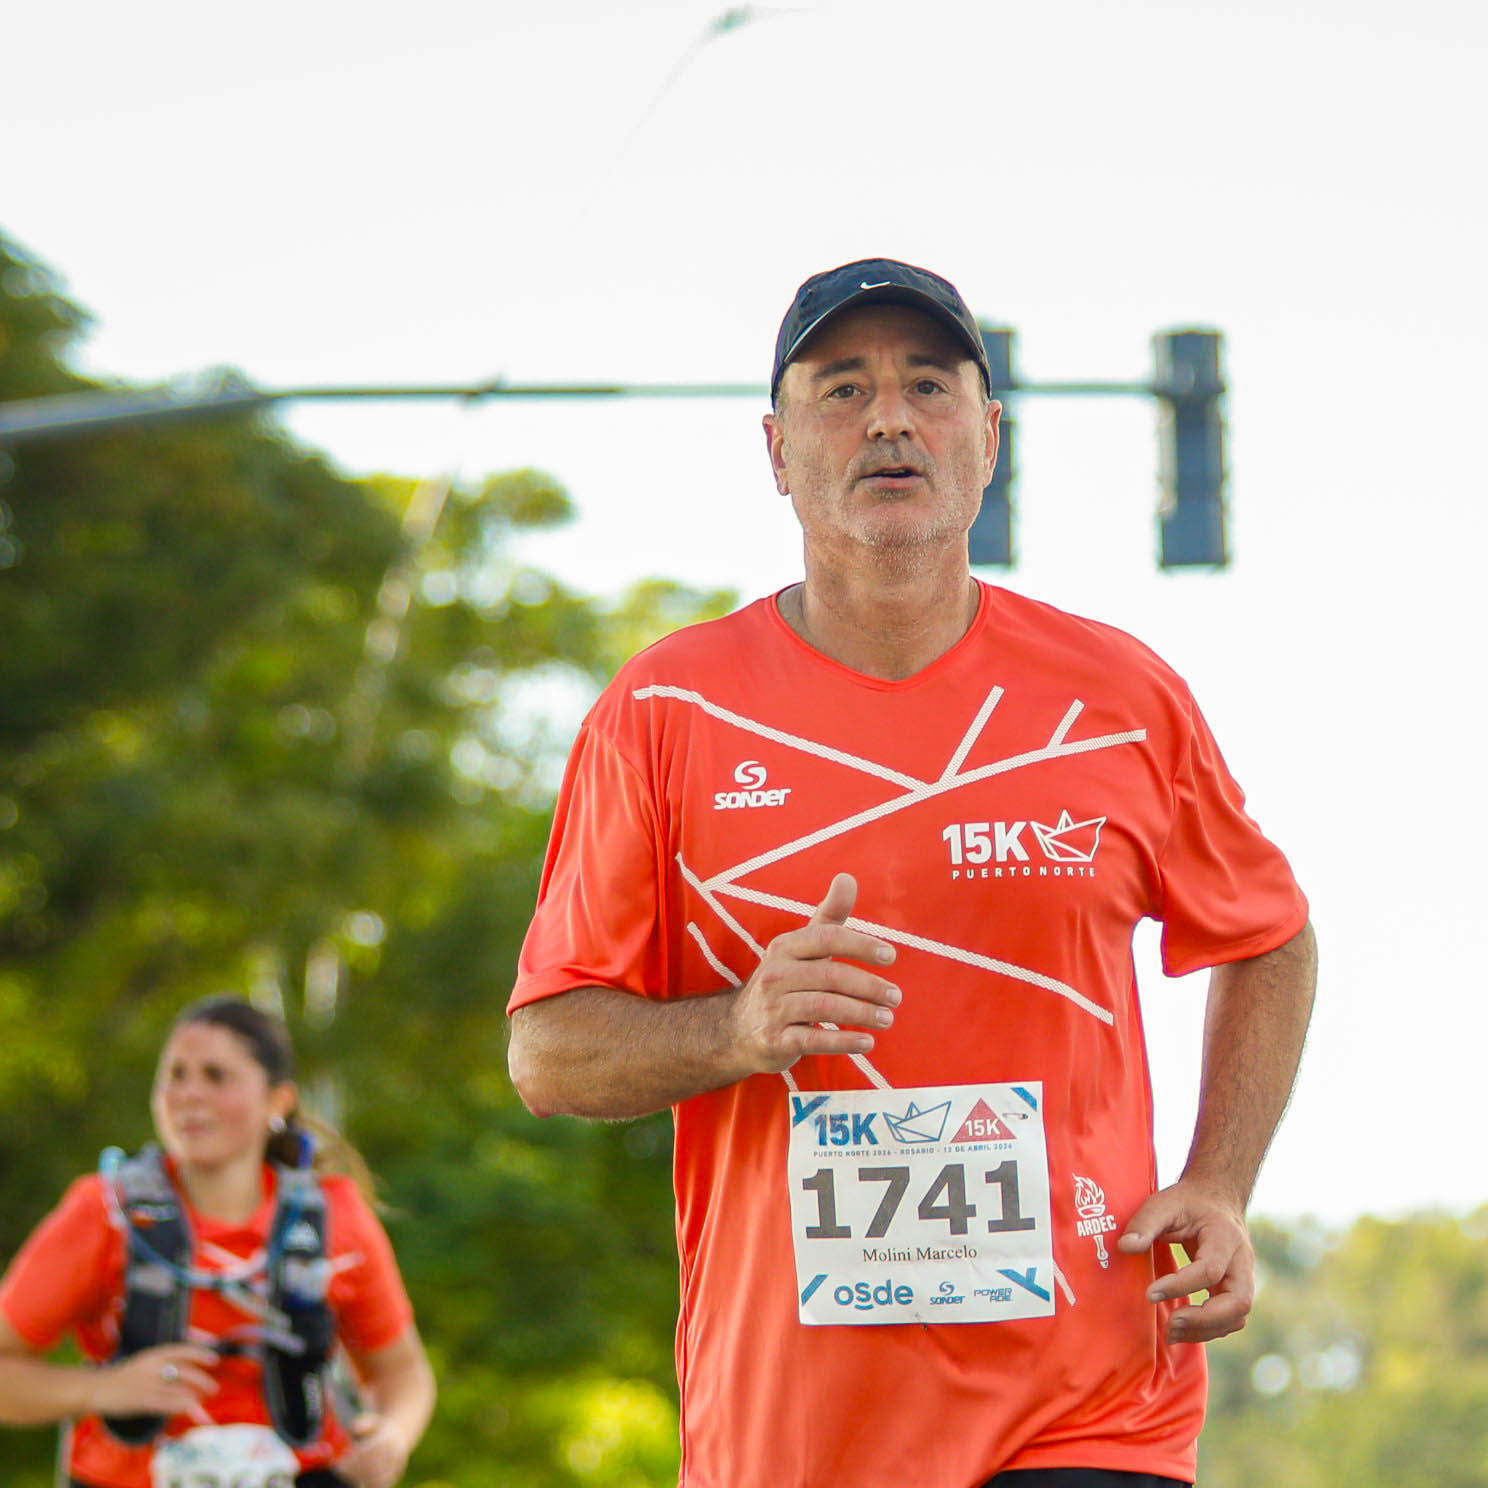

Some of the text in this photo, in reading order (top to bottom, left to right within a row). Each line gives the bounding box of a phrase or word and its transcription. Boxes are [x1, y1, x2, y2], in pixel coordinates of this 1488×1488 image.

[943, 821, 1030, 865] 15K
[952, 866, 1096, 880] PUERTO NORTE
[815, 1112, 879, 1146] 15K
[965, 1118, 1001, 1137] 15K
[813, 1150, 843, 1158] PUERTO
[845, 1149, 870, 1157] NORTE
[900, 1146, 935, 1155] ROSARIO
[944, 1145, 952, 1153] 12
[955, 1145, 966, 1153] DE
[968, 1143, 992, 1152] ABRIL
[802, 1160, 1036, 1238] 1741
[1076, 1214, 1117, 1237] ARDEC
[863, 1244, 977, 1262] Molini Marcelo
[833, 1279, 914, 1310] osde
[974, 1288, 1013, 1297] POWER
